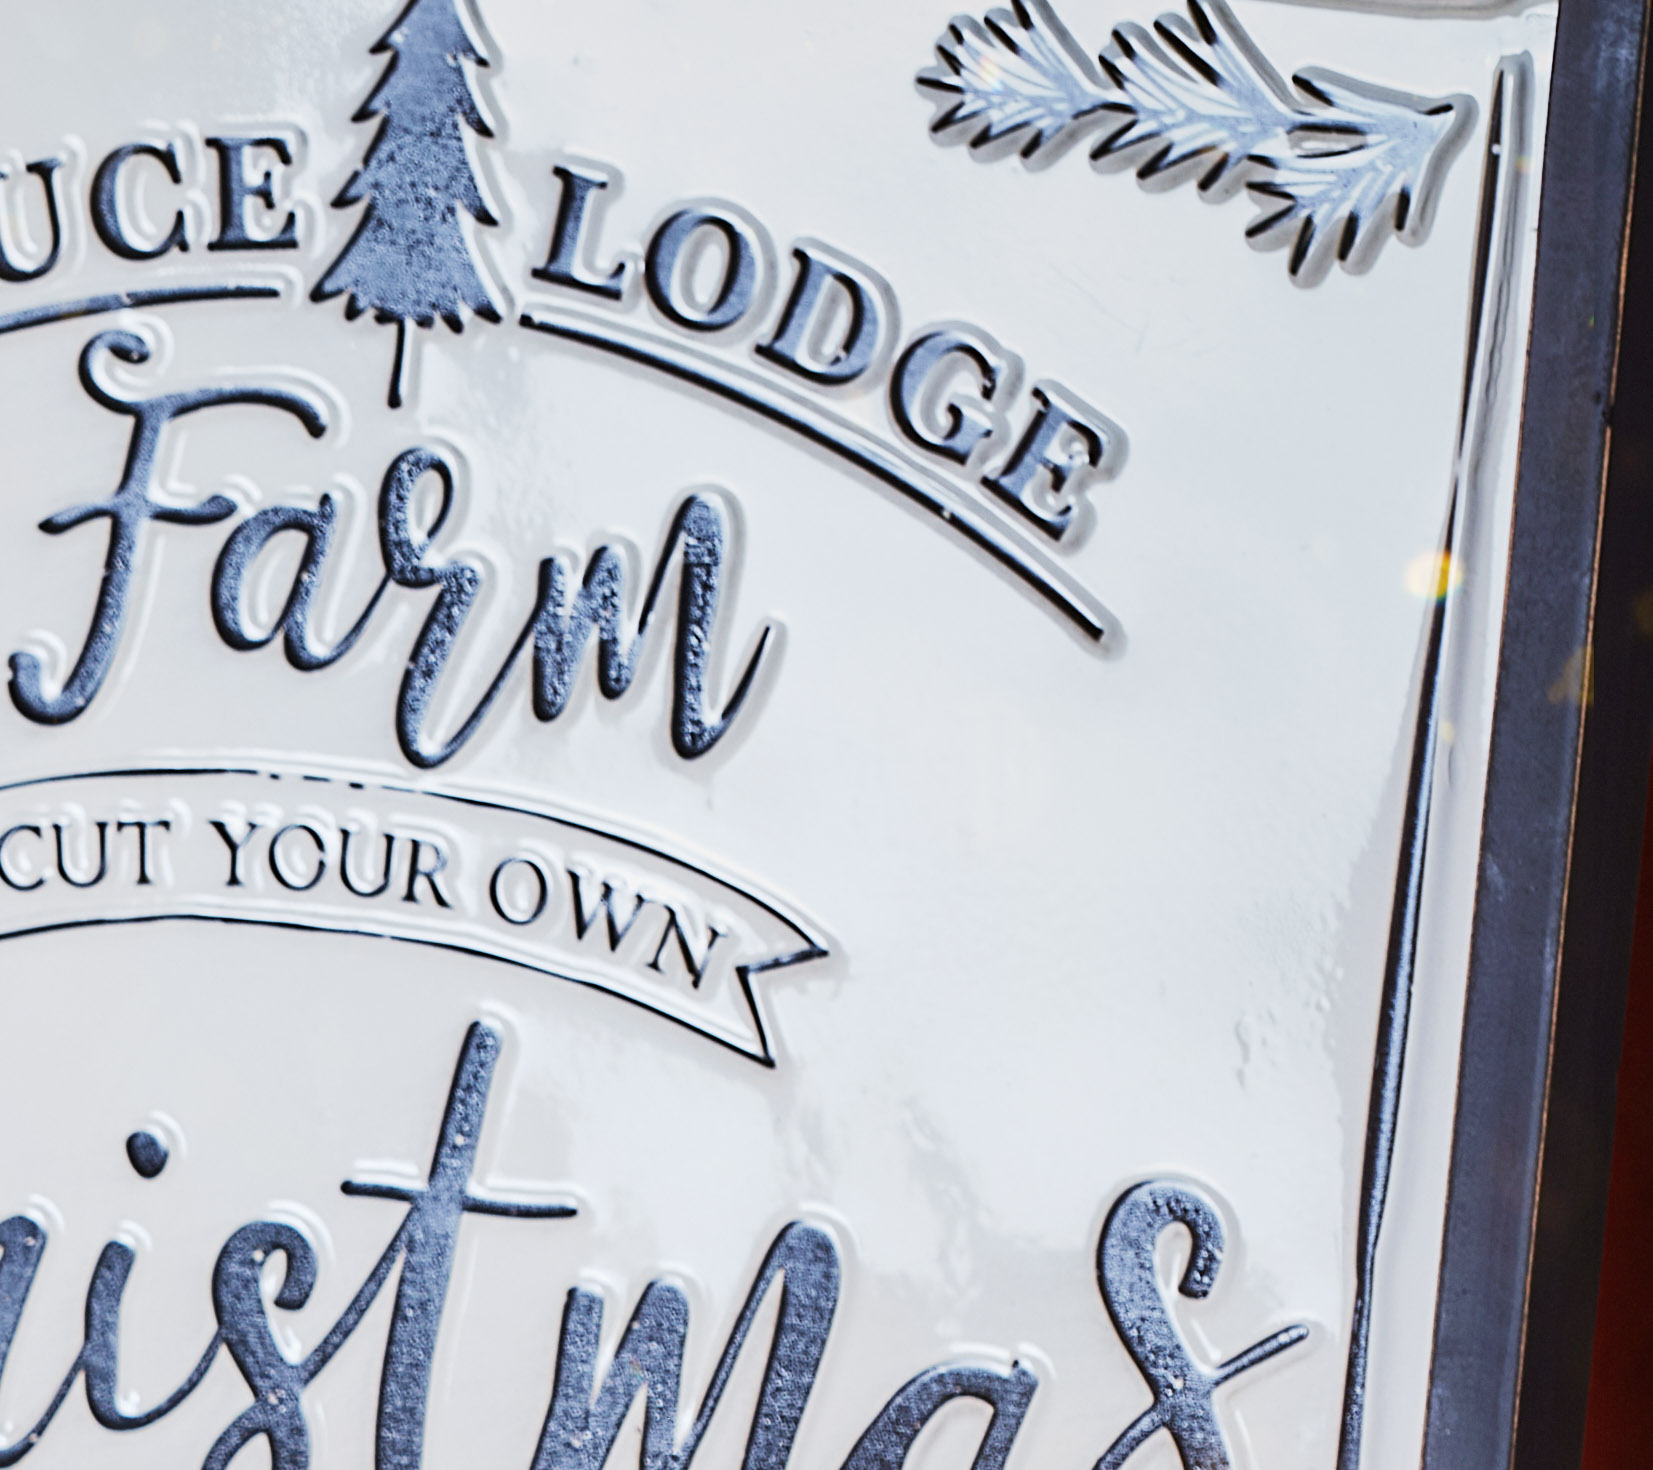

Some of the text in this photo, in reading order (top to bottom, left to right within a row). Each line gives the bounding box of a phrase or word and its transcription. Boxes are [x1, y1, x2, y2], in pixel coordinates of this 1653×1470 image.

[531, 165, 1104, 540] LODGE
[8, 329, 771, 768] Farm
[208, 818, 452, 909] YOUR
[488, 856, 726, 989] OWN
